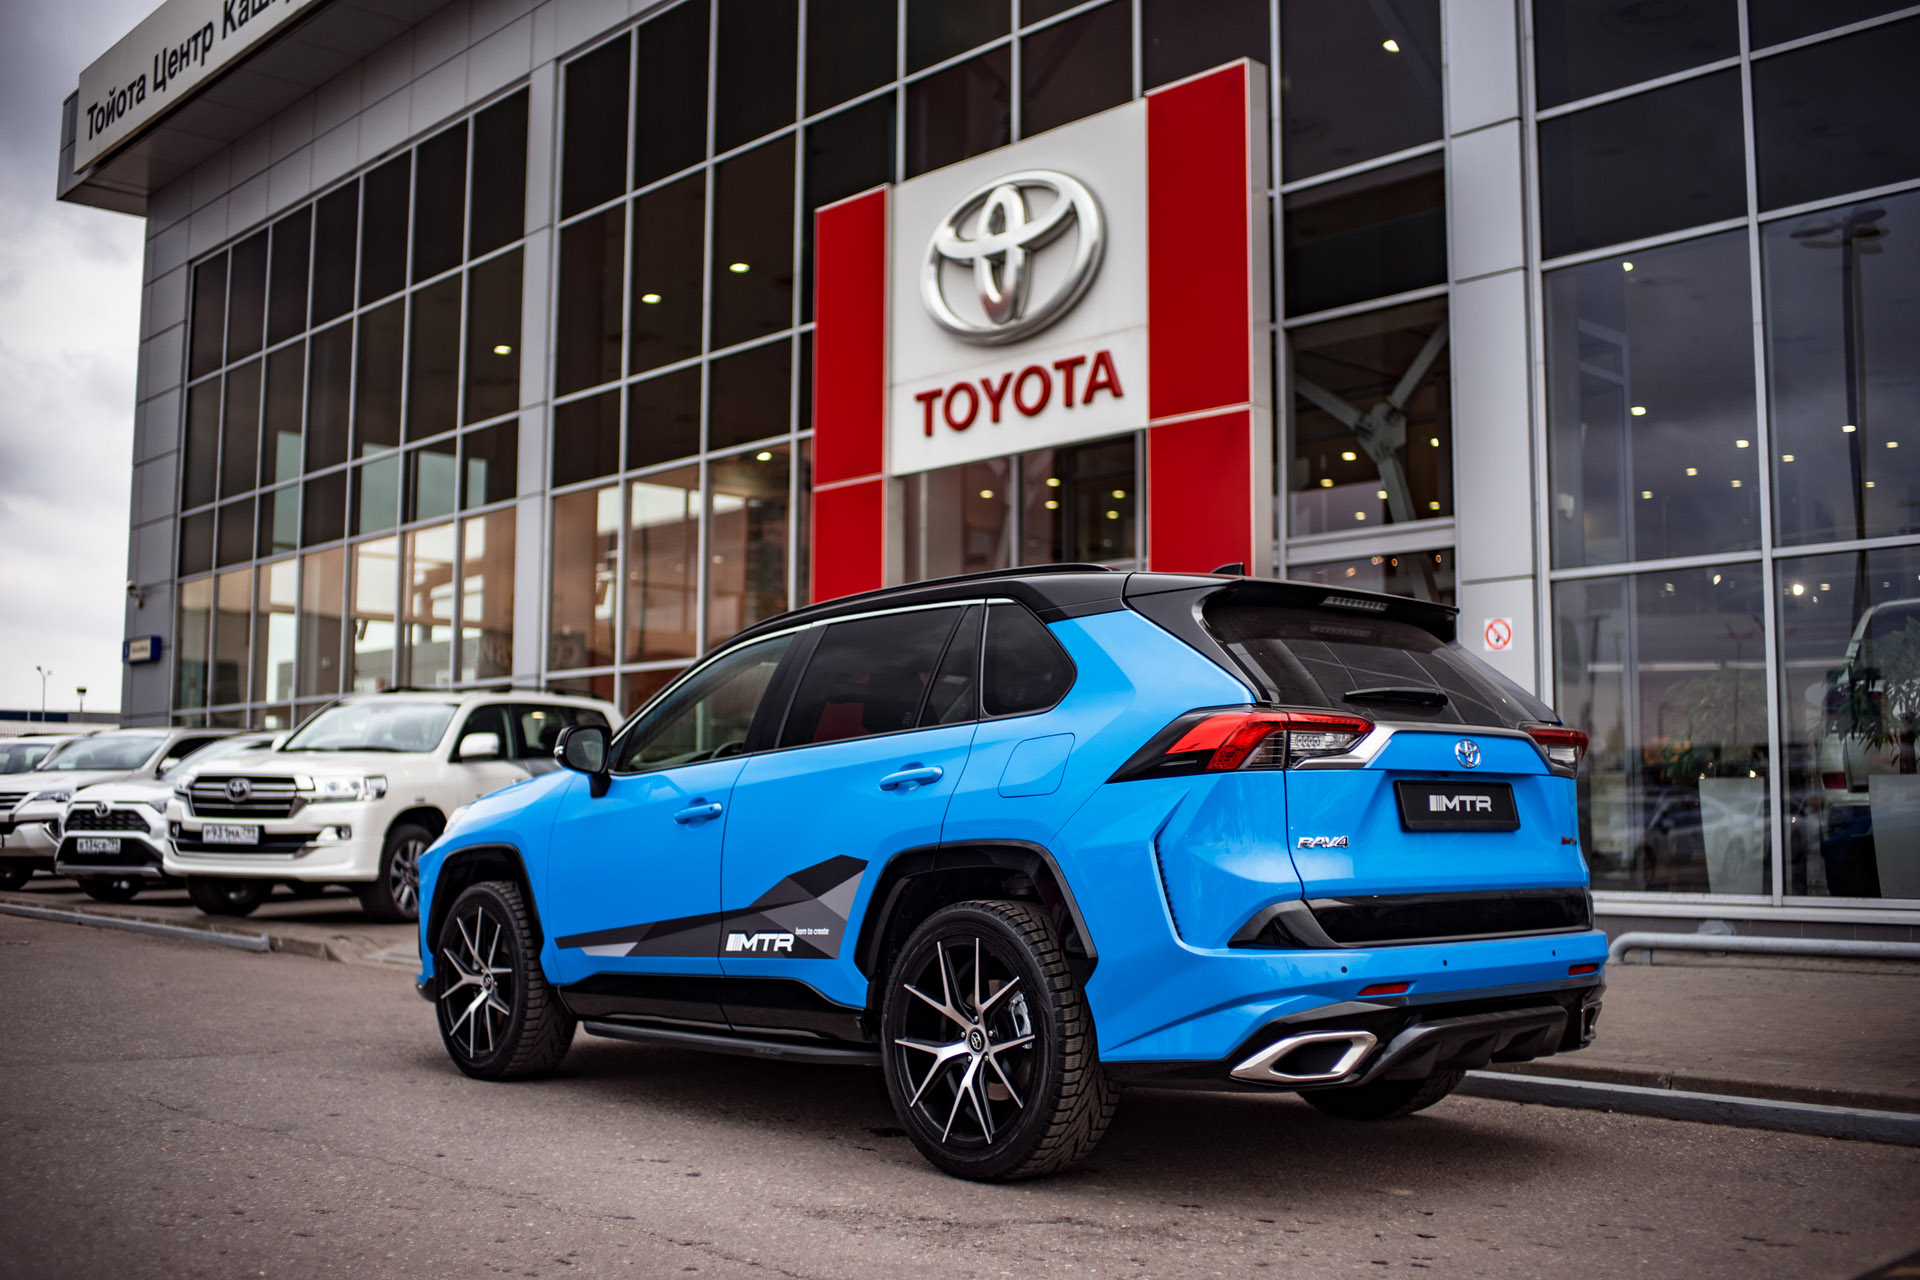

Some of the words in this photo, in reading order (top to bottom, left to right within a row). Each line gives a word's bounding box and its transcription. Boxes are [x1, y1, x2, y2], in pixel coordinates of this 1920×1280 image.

[86, 73, 147, 140] Тойота
[153, 20, 214, 93] Центр
[914, 349, 1124, 437] TOYOTA
[1441, 795, 1492, 812] MTR
[1297, 836, 1350, 849] RAV4
[738, 933, 795, 952] MTR
